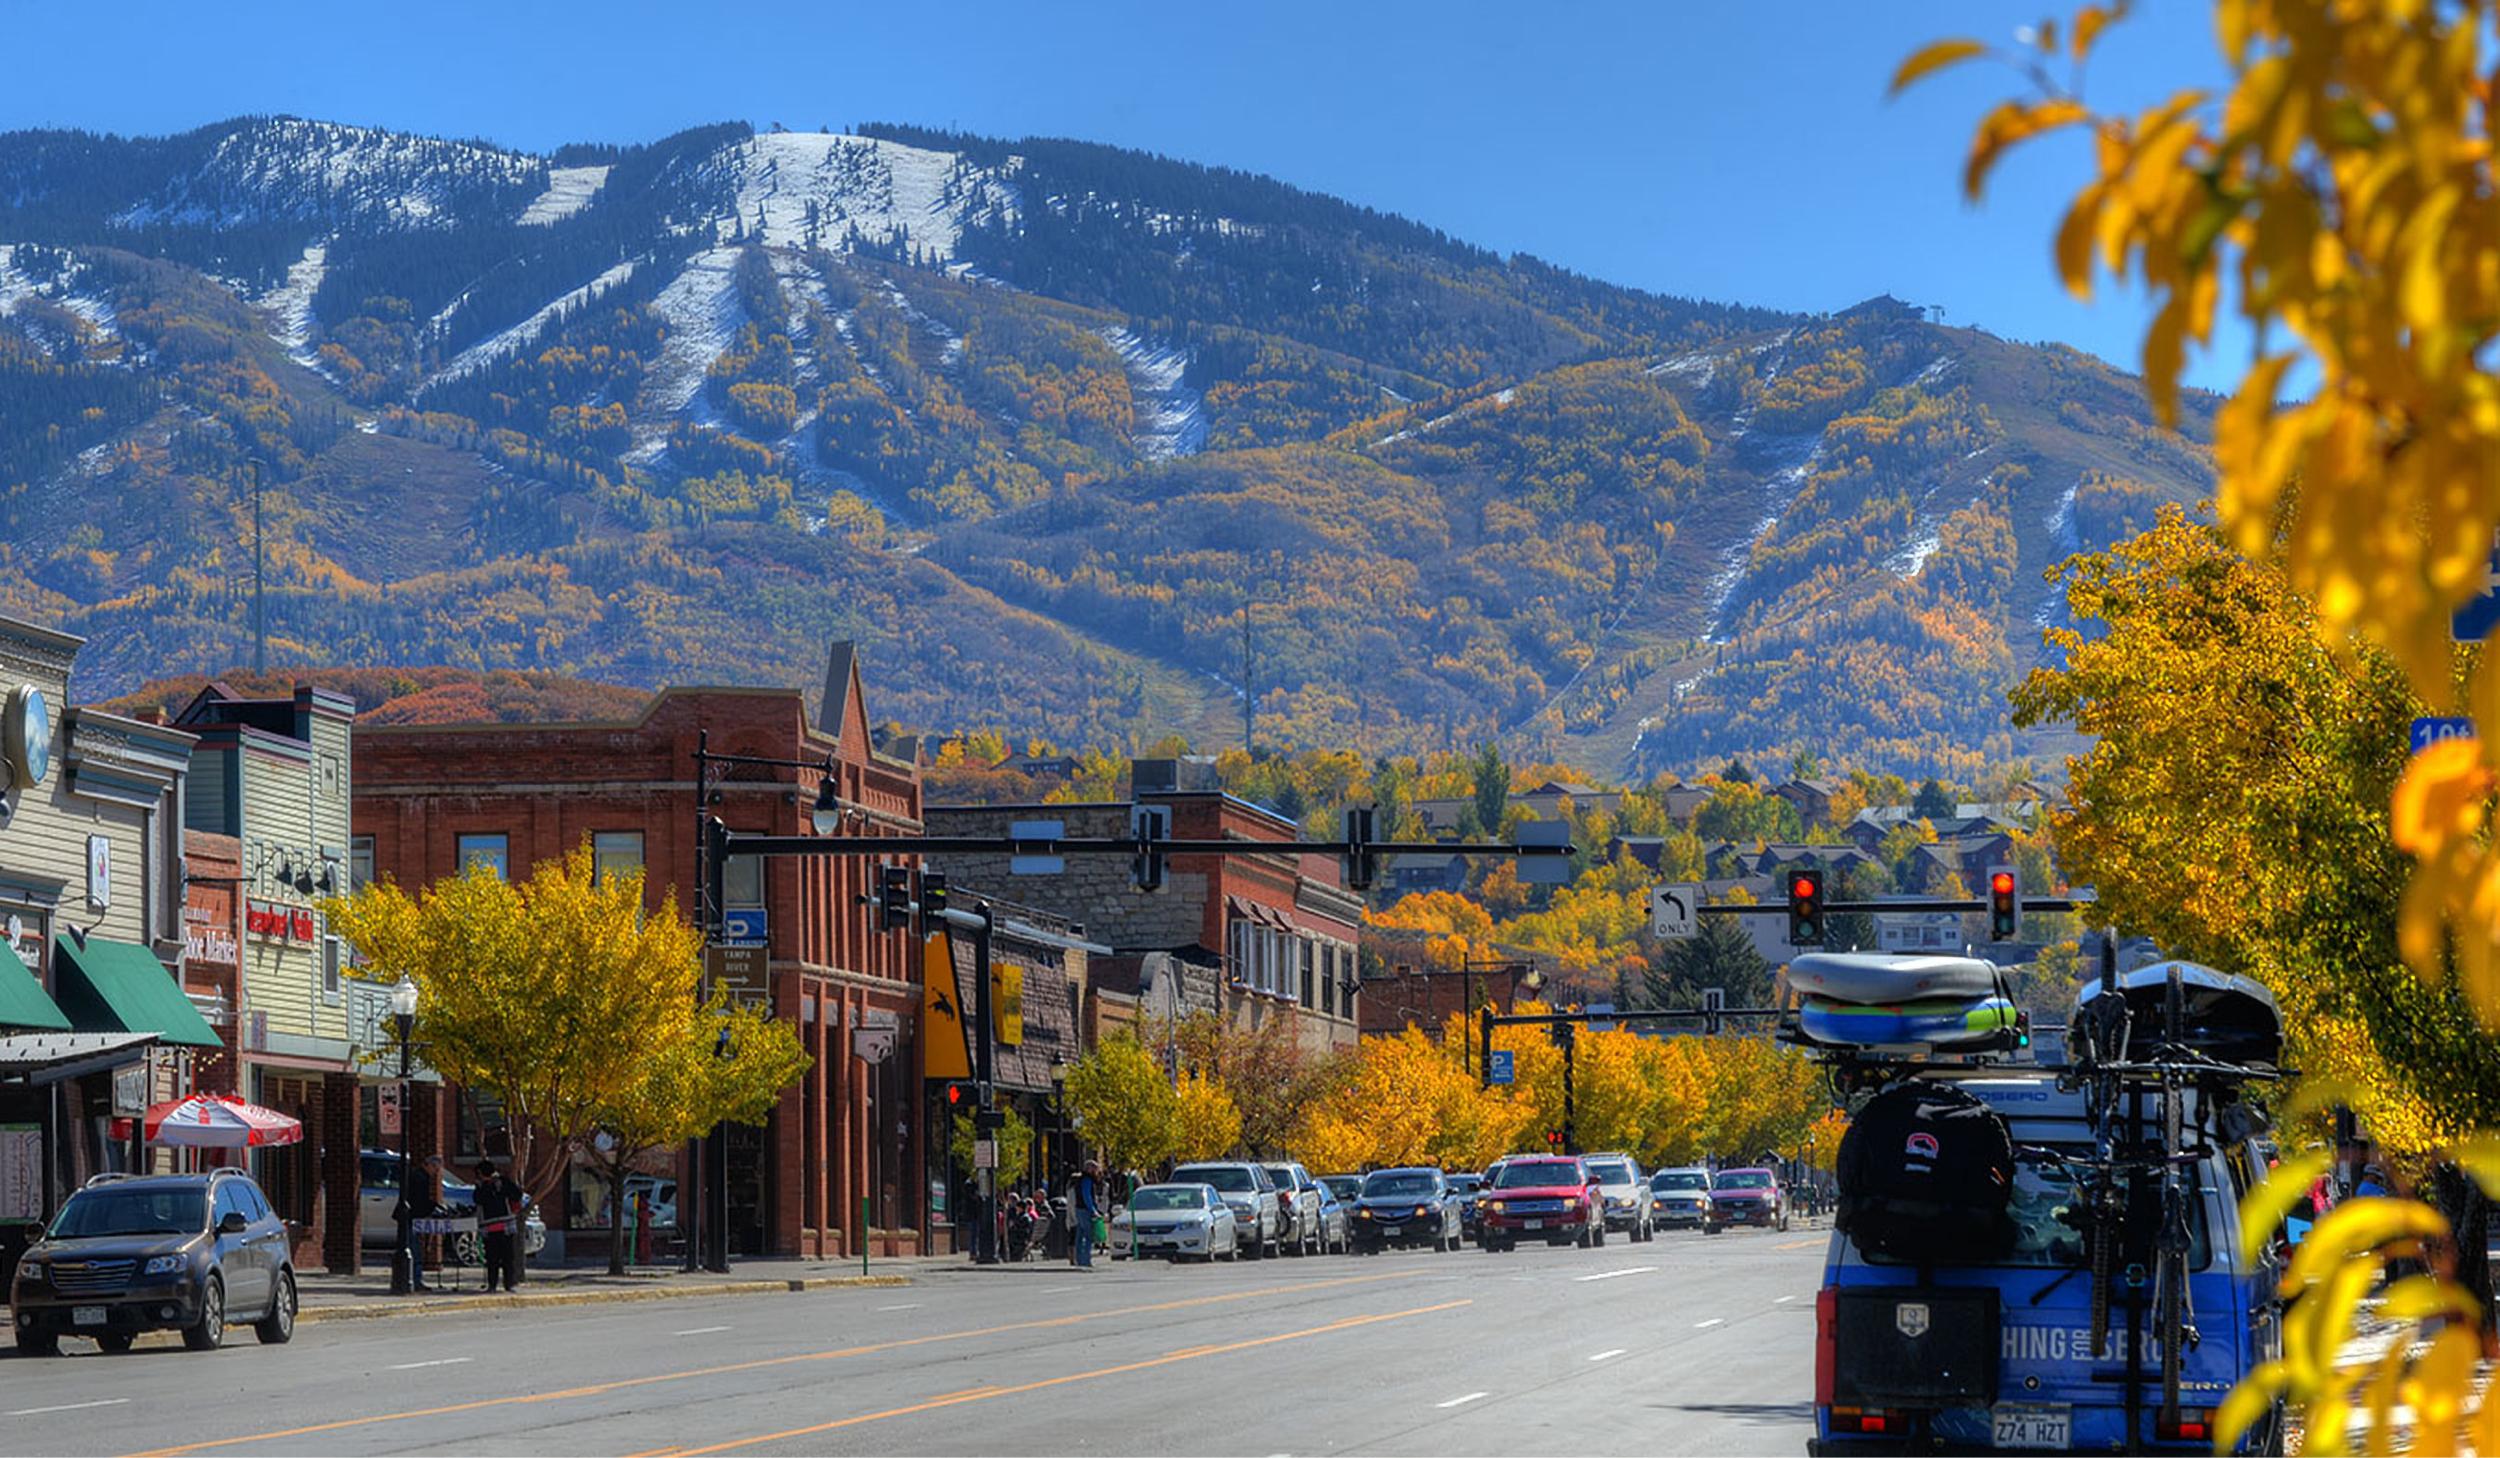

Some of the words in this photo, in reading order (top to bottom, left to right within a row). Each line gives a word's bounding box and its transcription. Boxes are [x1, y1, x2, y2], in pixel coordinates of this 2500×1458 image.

[1658, 923, 1690, 934] ONLY
[414, 1219, 452, 1233] SALE
[1997, 1422, 2027, 1442] Z74
[2036, 1422, 2067, 1442] HZT
